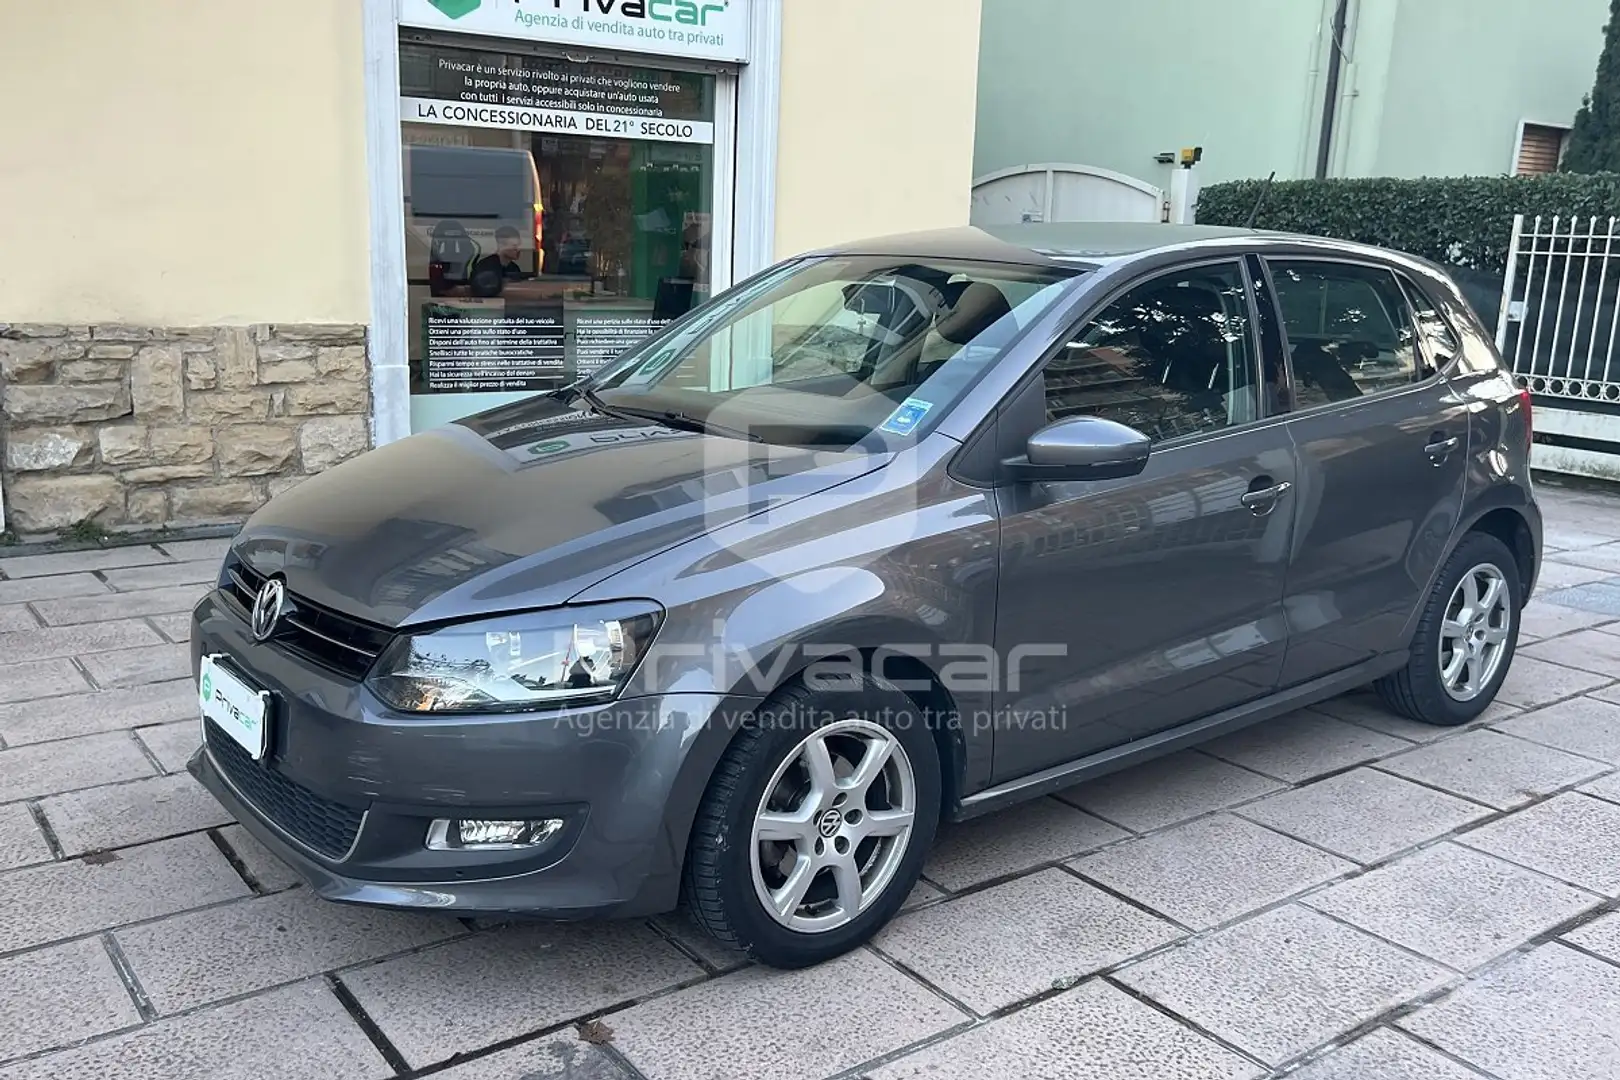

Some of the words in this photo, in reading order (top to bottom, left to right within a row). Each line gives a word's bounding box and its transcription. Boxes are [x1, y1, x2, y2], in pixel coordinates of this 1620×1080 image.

[514, 9, 569, 28] Agenzia
[571, 16, 584, 30] di
[587, 20, 634, 36] vendita
[637, 26, 665, 40] auto
[668, 30, 684, 42] tra
[687, 32, 724, 46] privati
[438, 58, 475, 73] Privacar
[476, 63, 482, 73] è
[484, 65, 496, 74] un
[498, 66, 531, 78] servizio
[531, 70, 560, 81] rivolto
[560, 72, 569, 82] ai
[569, 73, 597, 85] privati
[597, 76, 613, 87] che
[613, 78, 648, 91] vogliono
[649, 82, 681, 93] vendere
[464, 76, 472, 87] la
[474, 78, 507, 91] propria
[508, 81, 530, 93] auto,
[531, 84, 563, 96] oppure
[564, 87, 606, 99] acquistare
[607, 91, 637, 102] un'auto
[638, 94, 659, 104] usata
[418, 104, 438, 119] LA
[442, 105, 578, 131] CONCESSIONARIA
[585, 118, 612, 133] DEL
[640, 122, 693, 138] SECOLO
[460, 90, 477, 101] con
[479, 91, 499, 103] tutti
[506, 95, 534, 106] servizi
[534, 98, 577, 110] accessibili
[578, 101, 596, 111] solo
[596, 102, 605, 113] in
[606, 104, 663, 118] concessionaria
